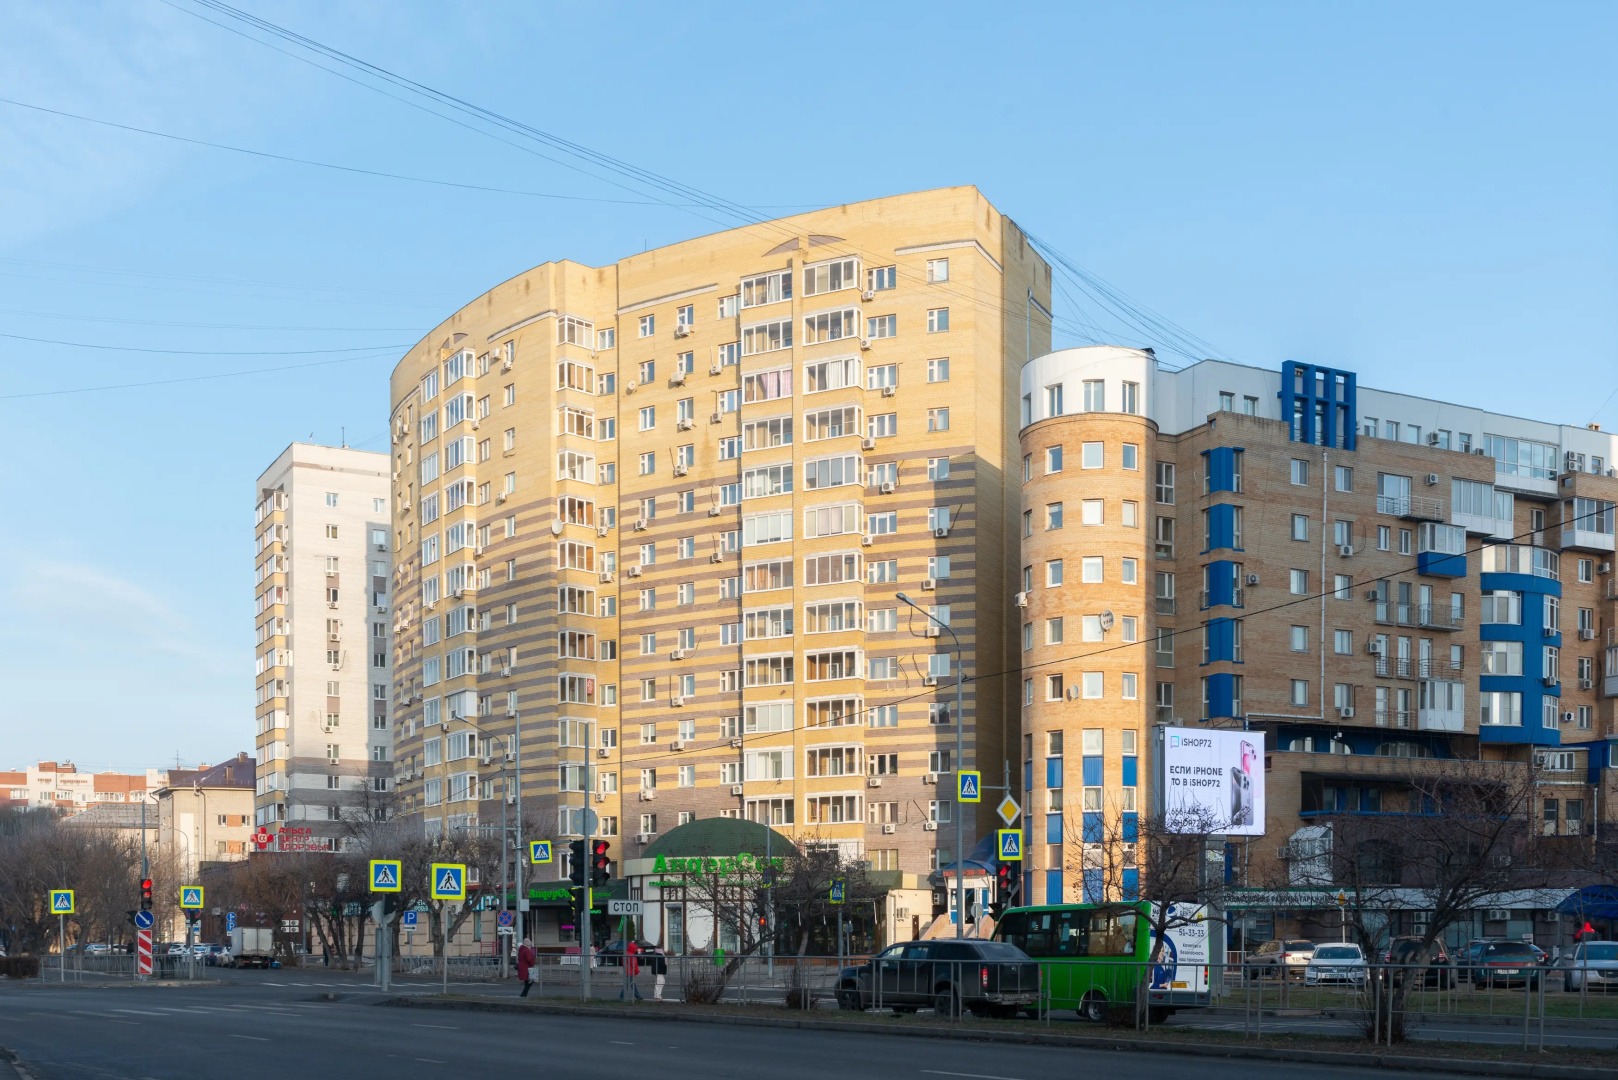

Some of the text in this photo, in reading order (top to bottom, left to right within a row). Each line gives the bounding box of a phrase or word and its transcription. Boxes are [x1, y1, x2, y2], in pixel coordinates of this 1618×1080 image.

[1181, 738, 1211, 747] iSHOP72
[1169, 765, 1222, 776] ЕСЛИ iPHONE
[1171, 777, 1220, 787] ТО В iSHOP72
[278, 827, 312, 835] АЛЬФА
[279, 835, 310, 843] ЦЕНТР
[278, 843, 330, 851] ЗДОРОВЬЯ
[529, 888, 573, 901] АндерСо
[613, 902, 639, 913] СТОП
